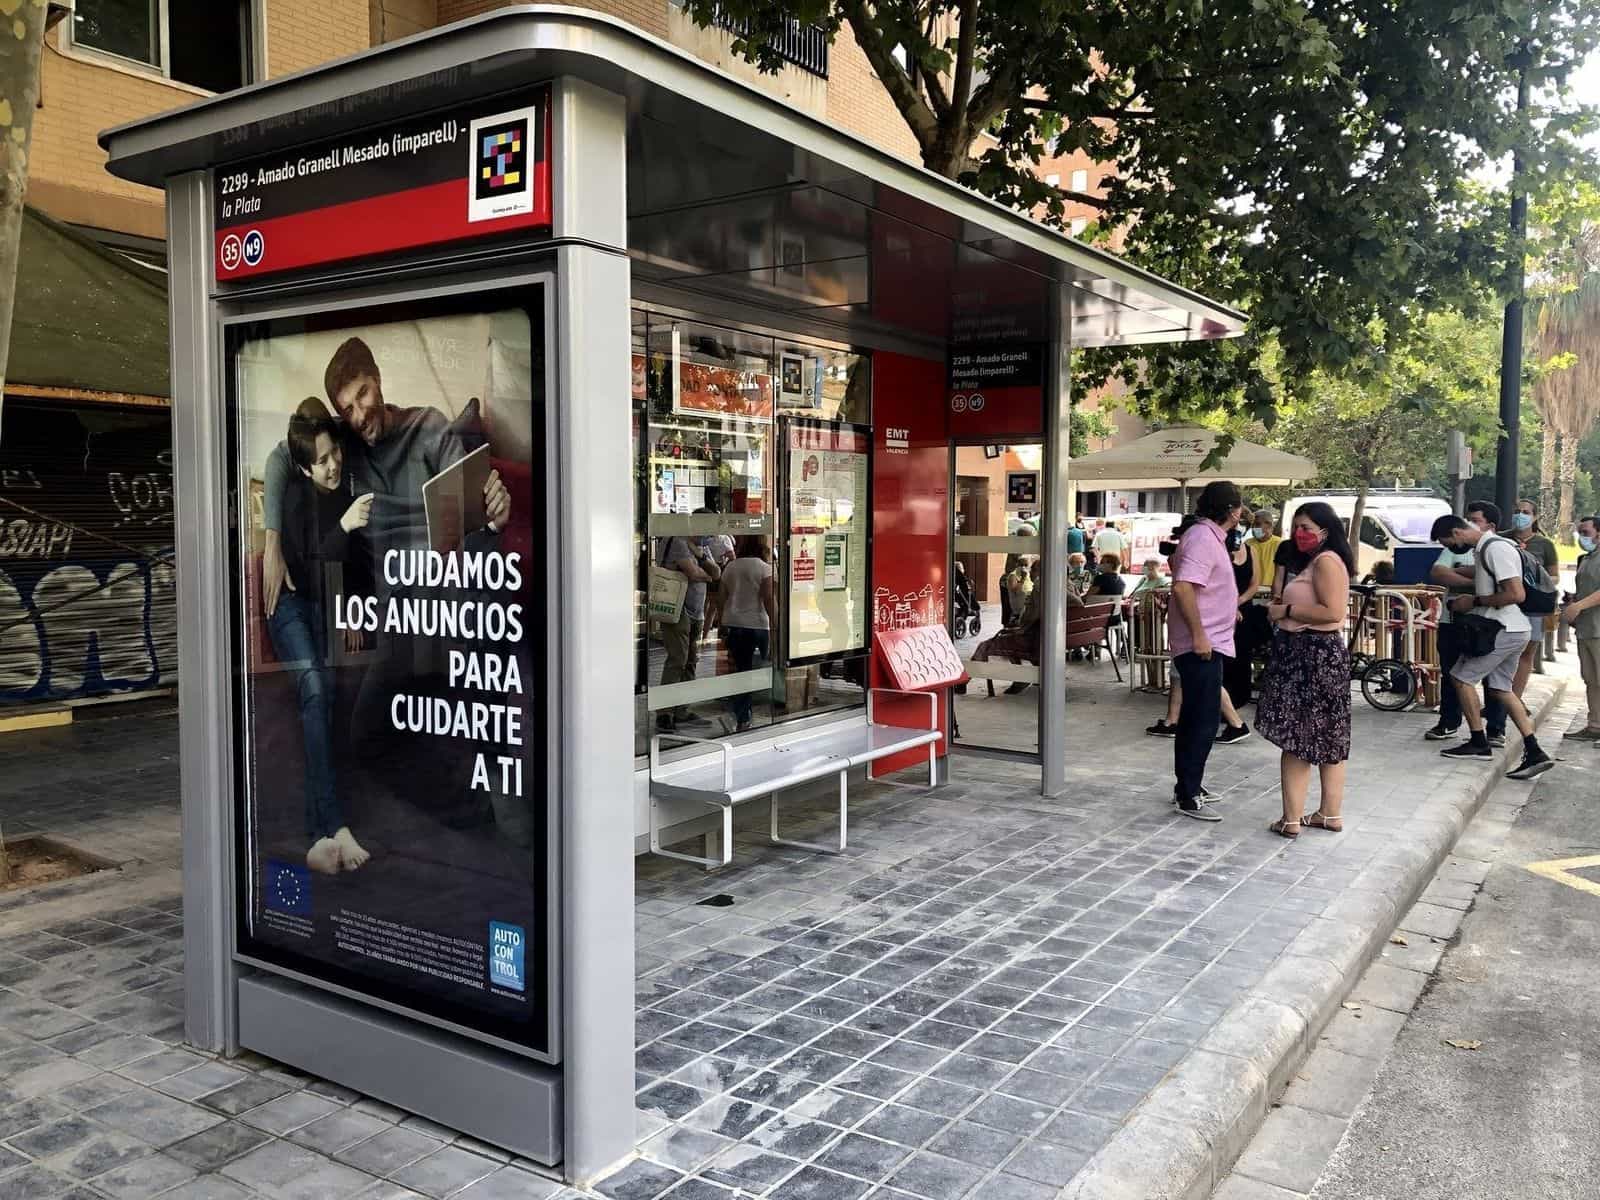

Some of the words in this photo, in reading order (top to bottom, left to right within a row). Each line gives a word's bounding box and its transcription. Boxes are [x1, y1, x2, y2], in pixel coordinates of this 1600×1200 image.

[222, 172, 249, 194] 2299
[257, 161, 295, 186] Amado
[297, 148, 341, 176] Granell
[342, 138, 389, 166] Mesado
[392, 119, 457, 156] (imparell)
[222, 201, 233, 218] la
[234, 196, 262, 216] Plata
[225, 243, 238, 262] 35
[246, 238, 261, 257] N9
[886, 427, 910, 440] EMT
[383, 549, 522, 591] CUIDAMOS
[335, 594, 378, 632] LOS
[383, 597, 523, 642] ANUNCIOS
[449, 650, 523, 694] PARA
[391, 694, 523, 746] CUIDARTE
[470, 753, 491, 792] A
[497, 756, 522, 797] TI
[494, 927, 520, 945] AUTO
[494, 944, 514, 961] CON
[494, 960, 519, 978] TROL
